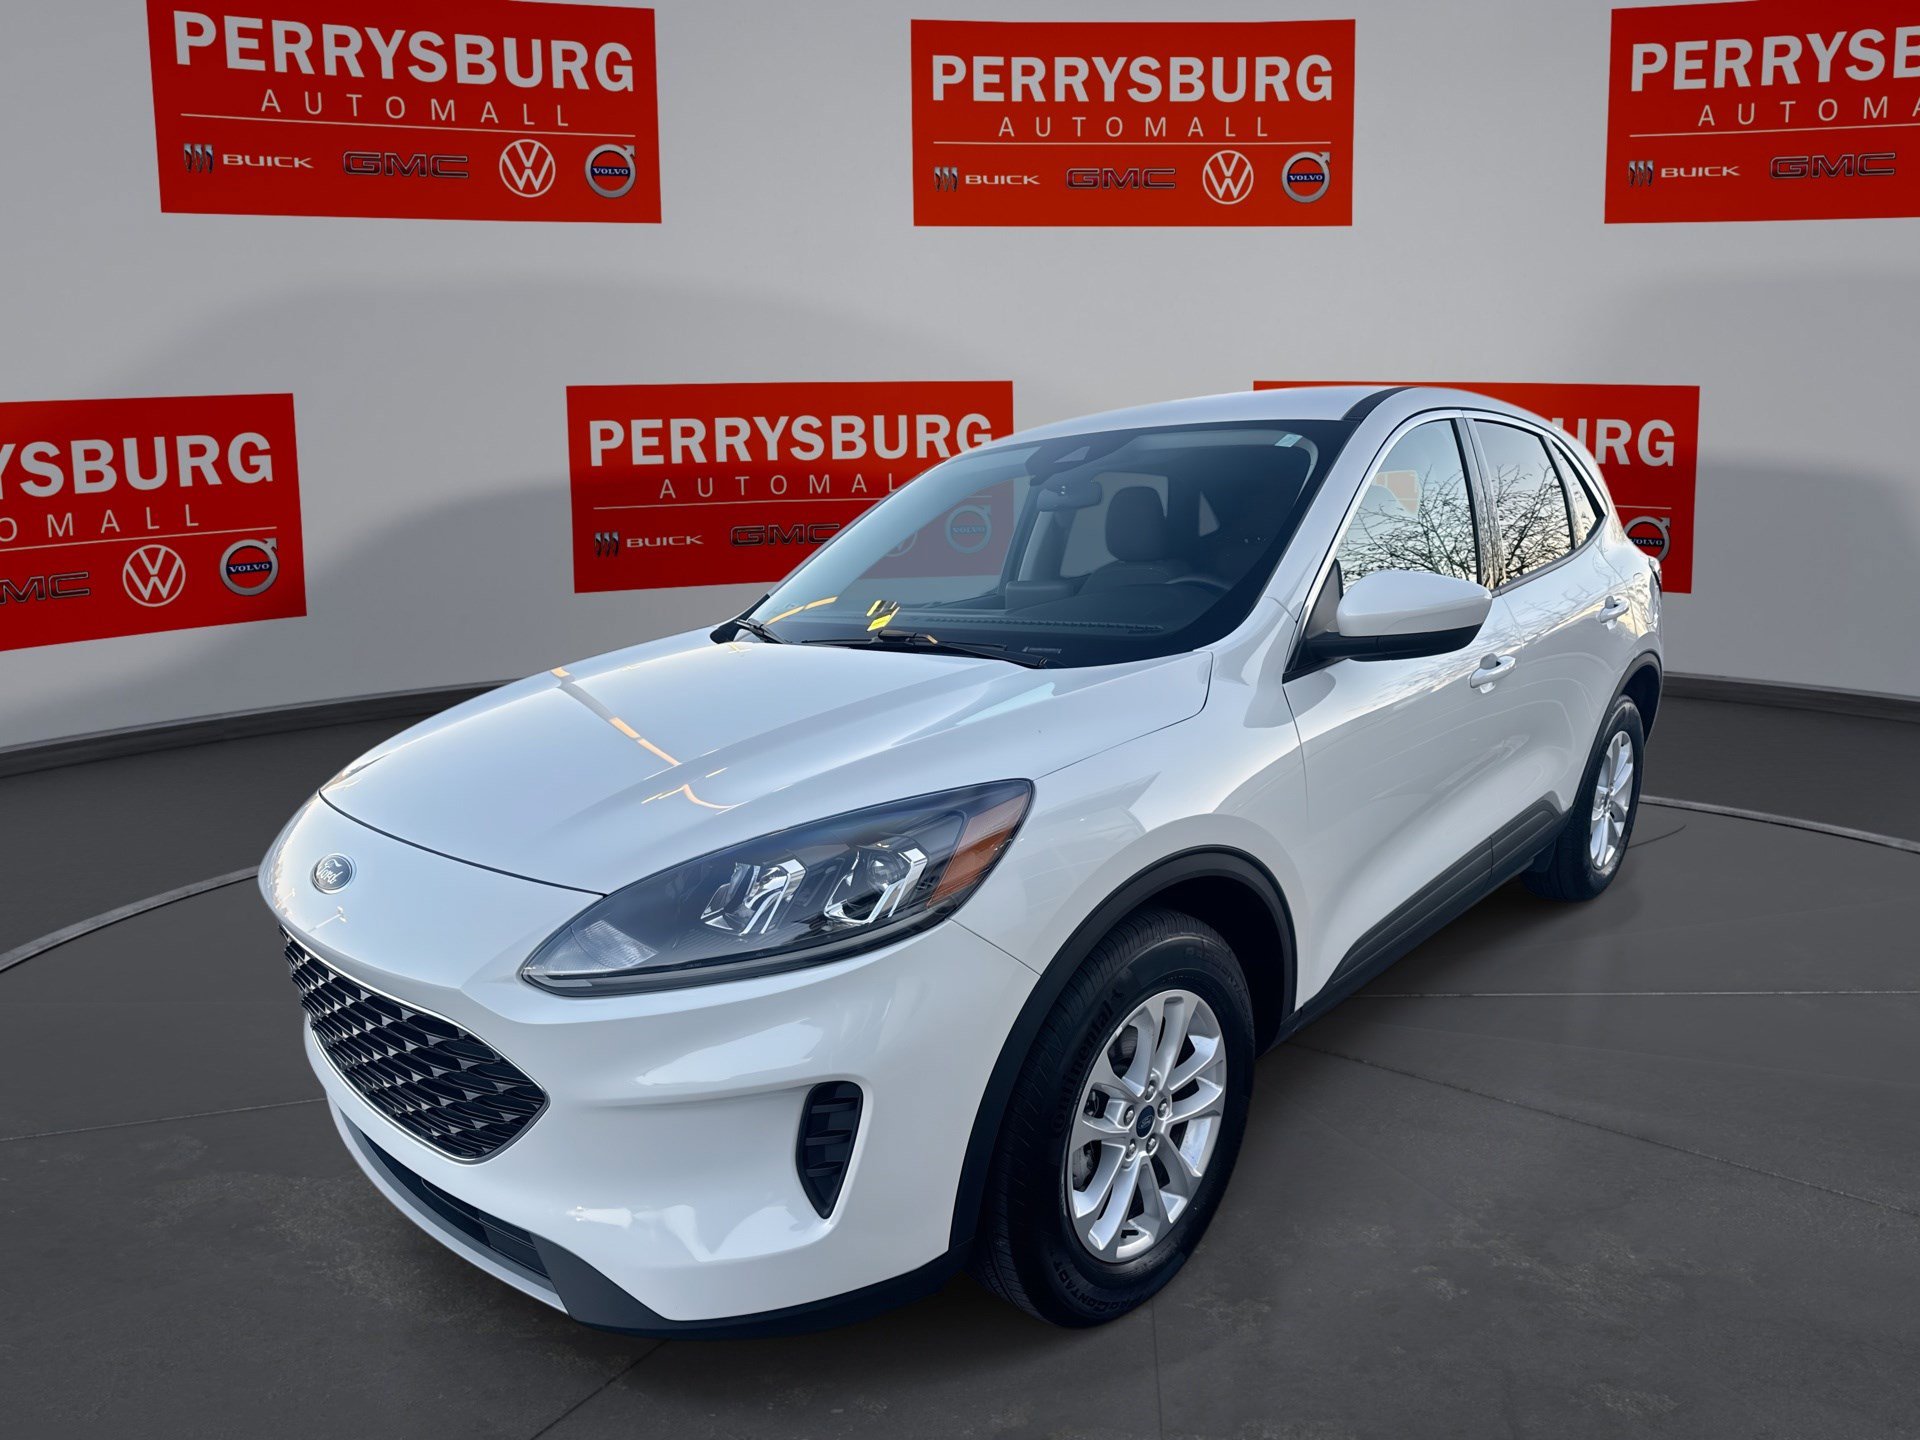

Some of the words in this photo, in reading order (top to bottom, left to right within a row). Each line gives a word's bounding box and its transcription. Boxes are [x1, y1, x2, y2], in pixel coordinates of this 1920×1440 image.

[173, 10, 634, 93] PERRYSBURG
[932, 54, 1333, 103] PERRYSBURG
[261, 89, 569, 127] AUTOMALL
[998, 116, 1268, 138] AUTOMALL
[222, 153, 314, 169] BUICK
[343, 151, 469, 179] GMC
[592, 167, 630, 177] VOLVO
[965, 174, 1041, 185] BUICK
[1066, 167, 1176, 189] GMC
[1288, 174, 1324, 182] VOLVO
[1660, 166, 1741, 178] BUICK
[1769, 152, 1896, 180] GMC
[589, 413, 993, 467] PERRYSBURG
[659, 473, 901, 499] AUTOMAL
[0, 504, 199, 542] OMALL
[626, 534, 704, 548] BUICK
[729, 523, 840, 547] GMC
[228, 562, 270, 573] VOLVO
